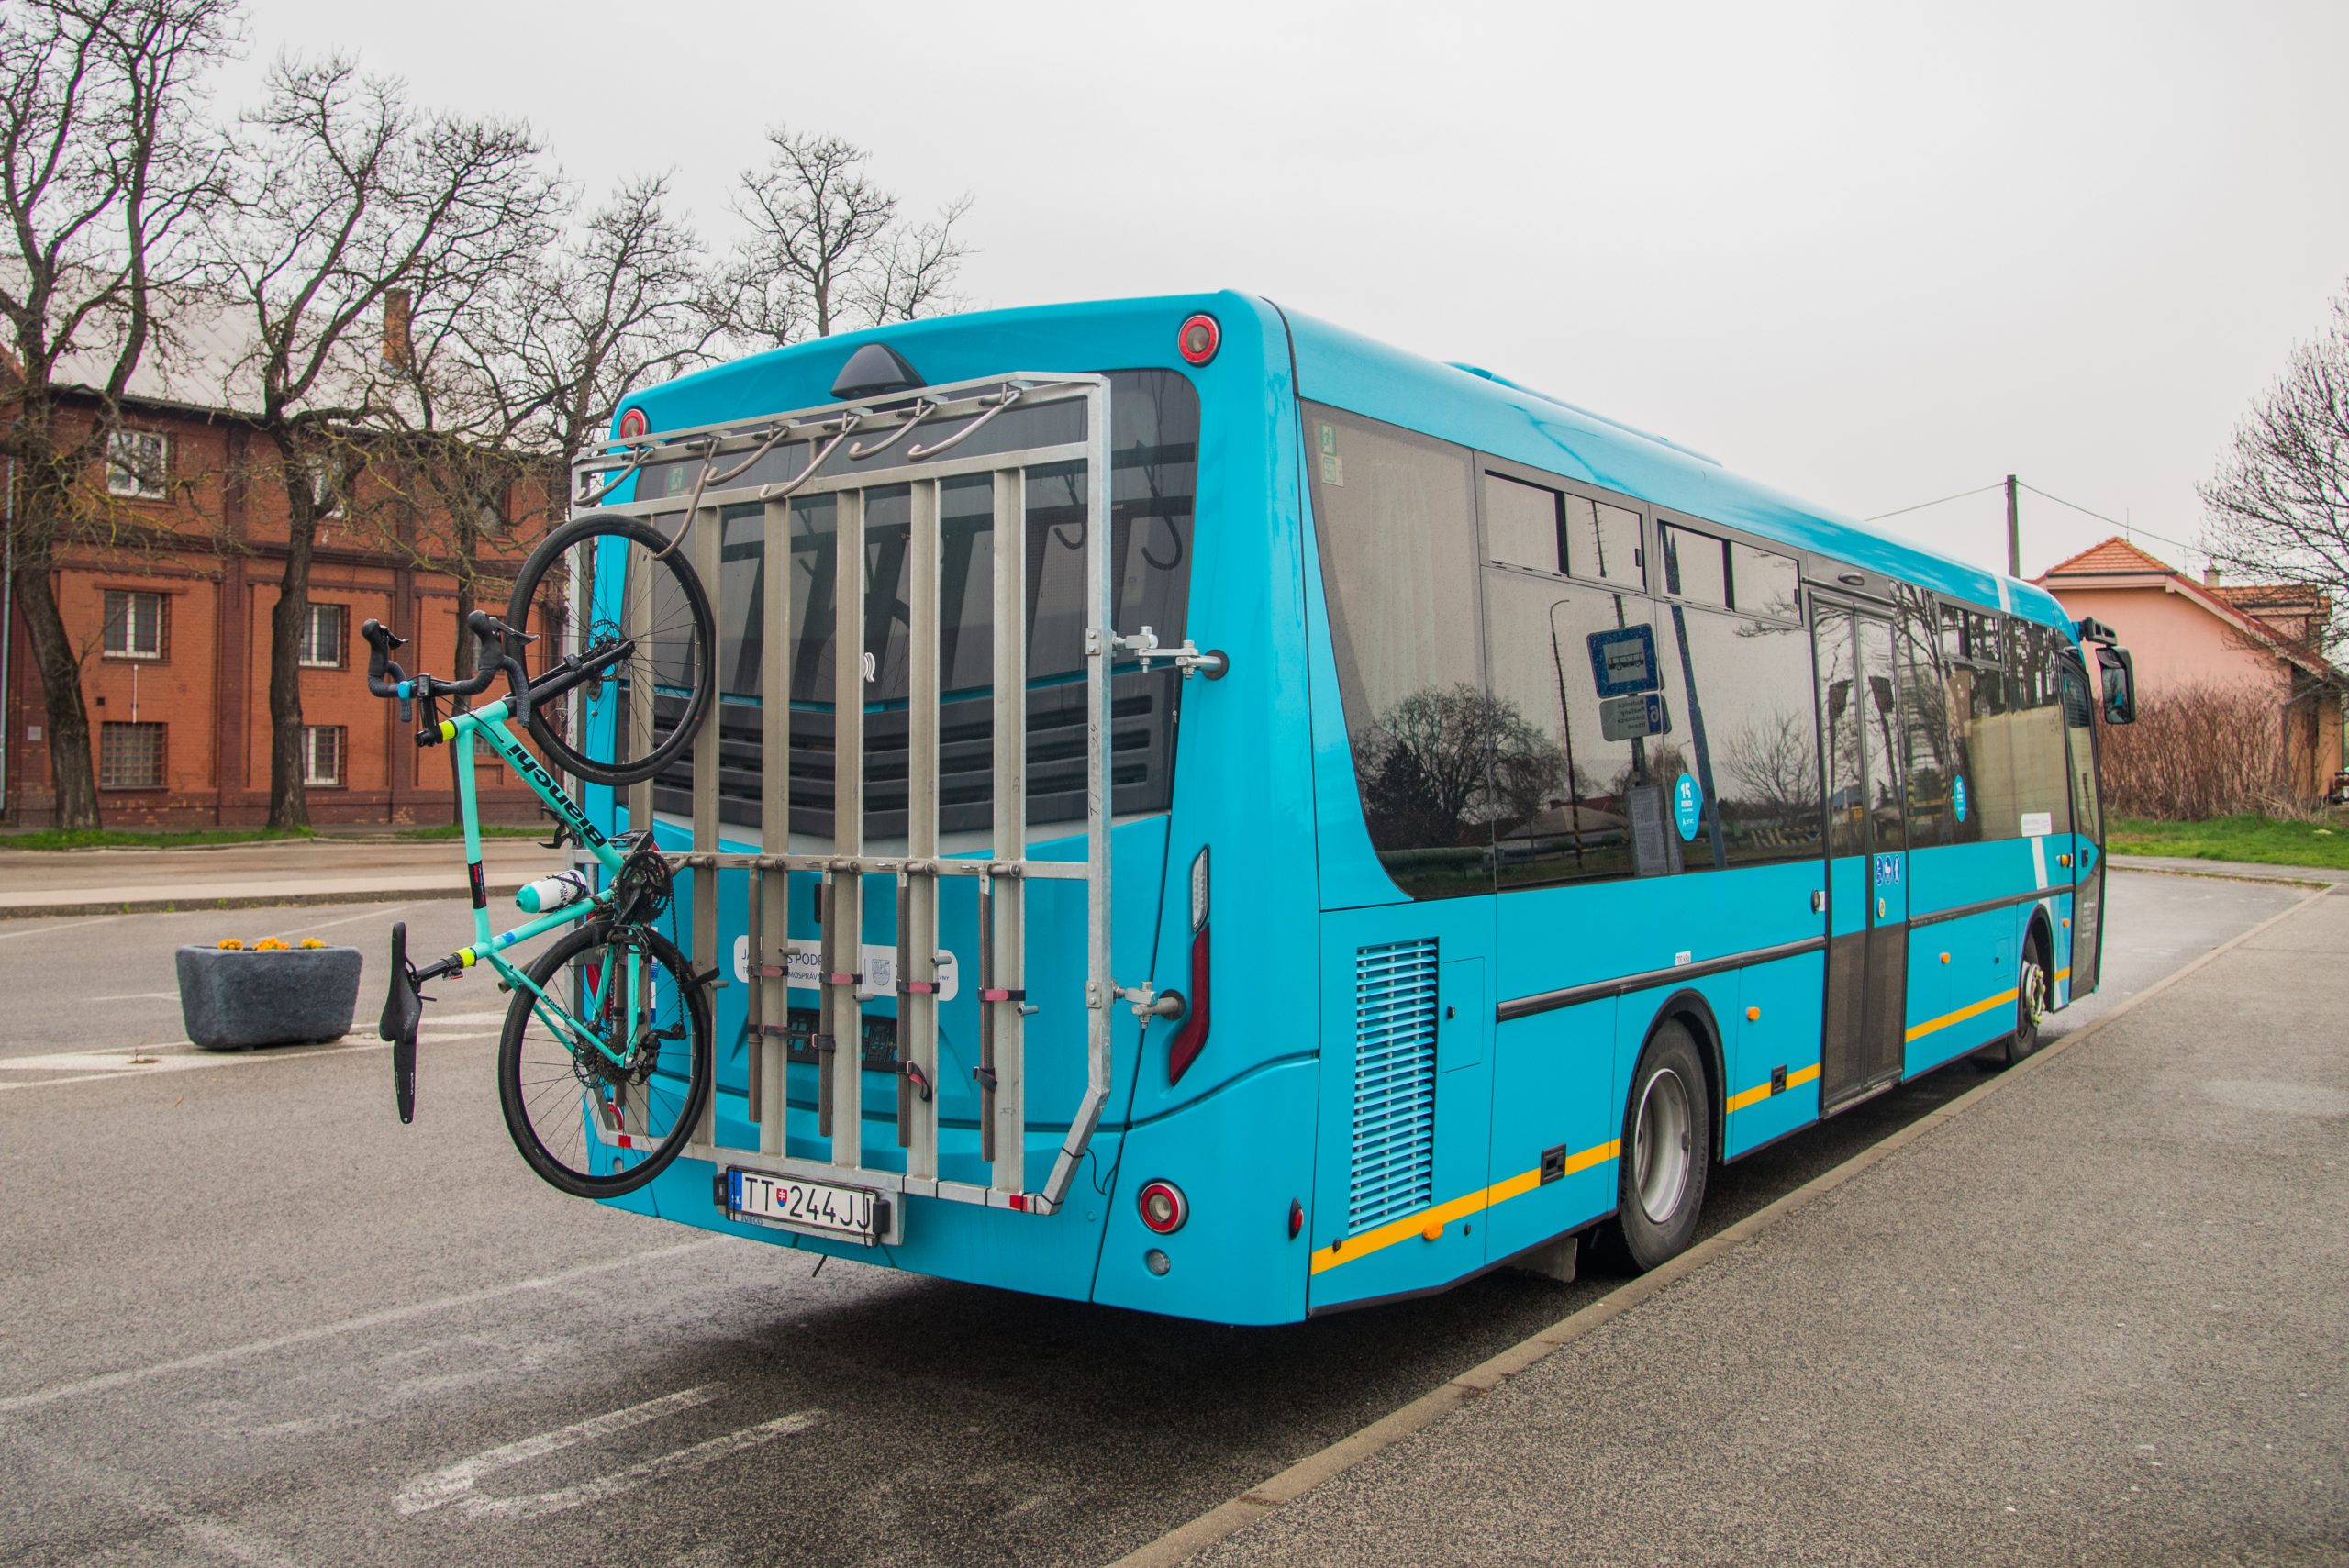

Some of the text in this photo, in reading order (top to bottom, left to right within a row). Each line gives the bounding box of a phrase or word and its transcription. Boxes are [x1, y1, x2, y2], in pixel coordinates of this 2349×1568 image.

[507, 742, 608, 848] Bianchi
[740, 1214, 763, 1226] IVECO
[745, 1177, 871, 1229] TT 244JJ
